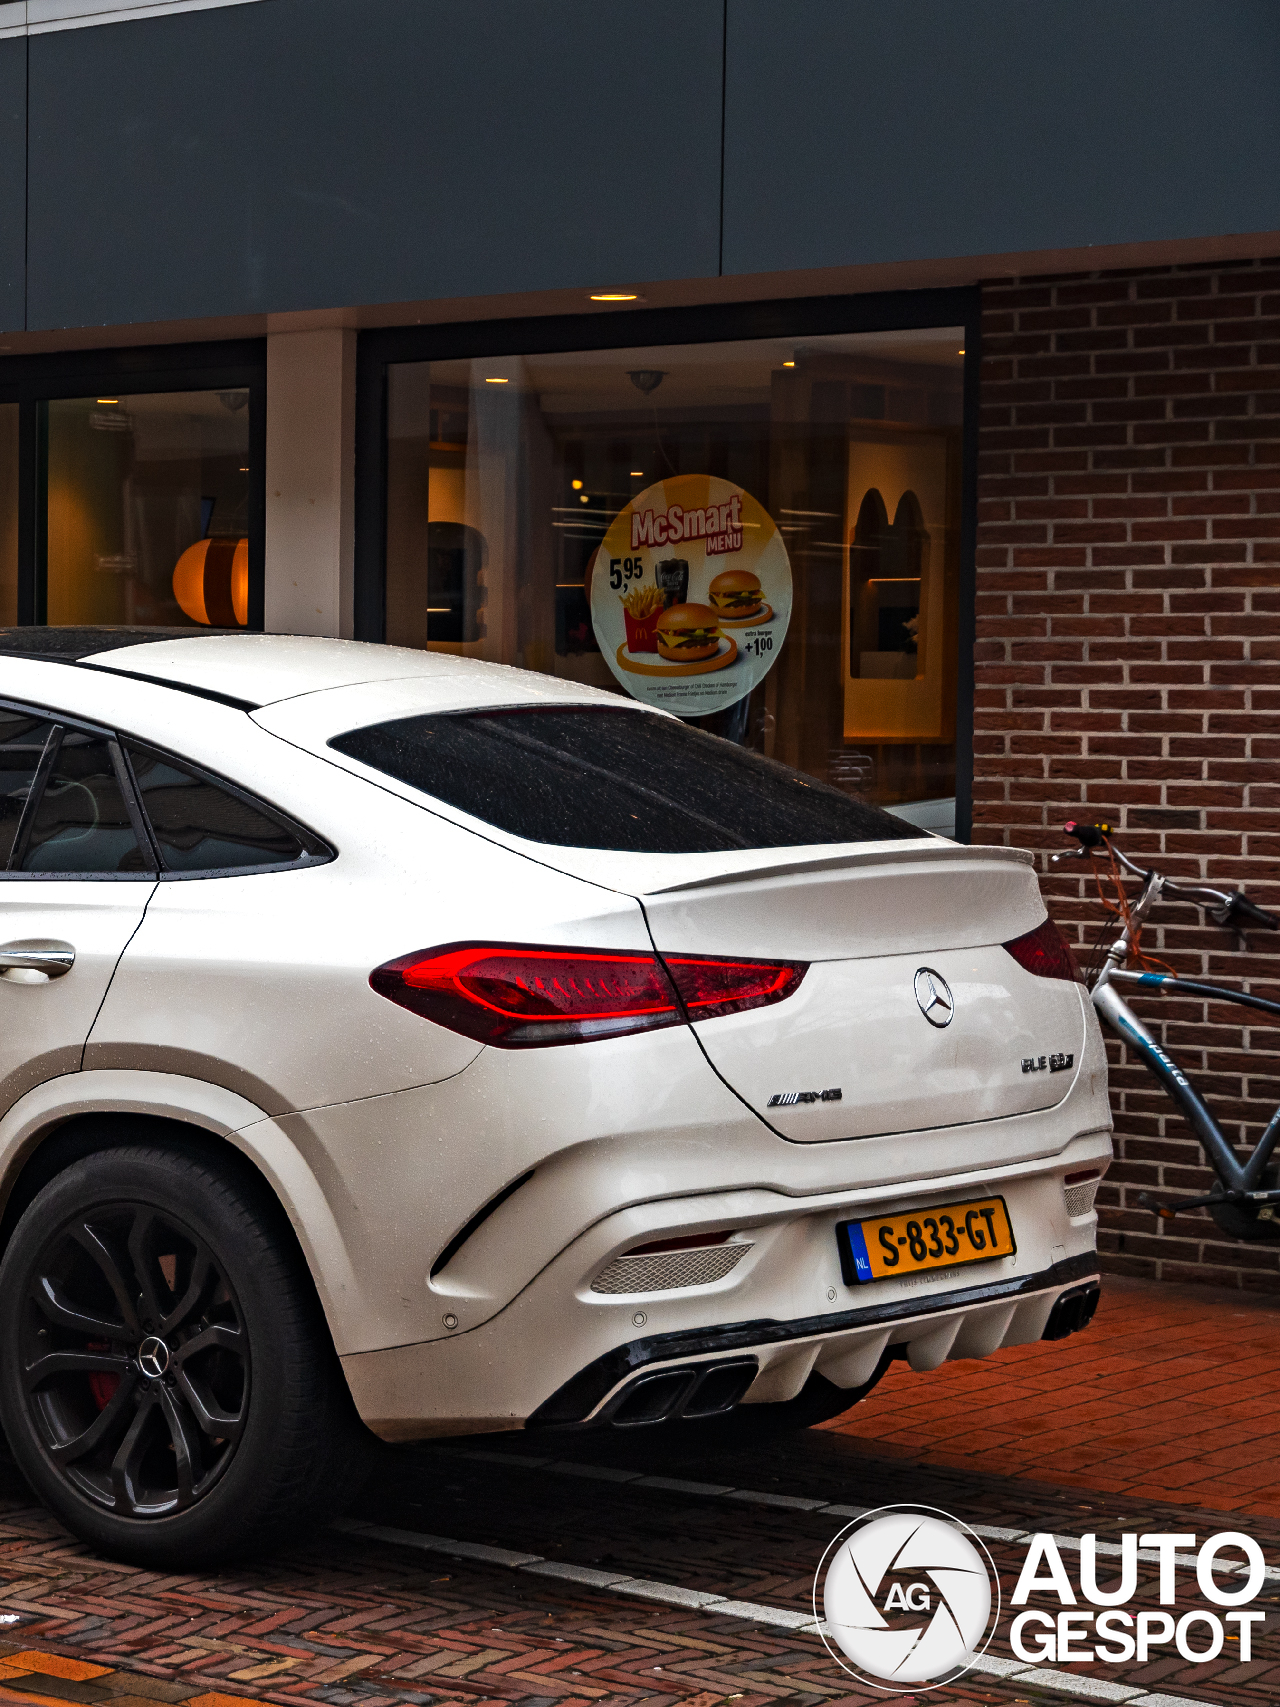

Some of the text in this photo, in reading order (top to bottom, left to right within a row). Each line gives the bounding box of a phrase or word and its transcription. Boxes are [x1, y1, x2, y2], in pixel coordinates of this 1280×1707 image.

[631, 495, 743, 550] McSmart
[707, 533, 742, 555] MENU
[609, 557, 643, 593] 5,95
[878, 1207, 998, 1267] S-833-GT
[856, 1257, 869, 1270] NL
